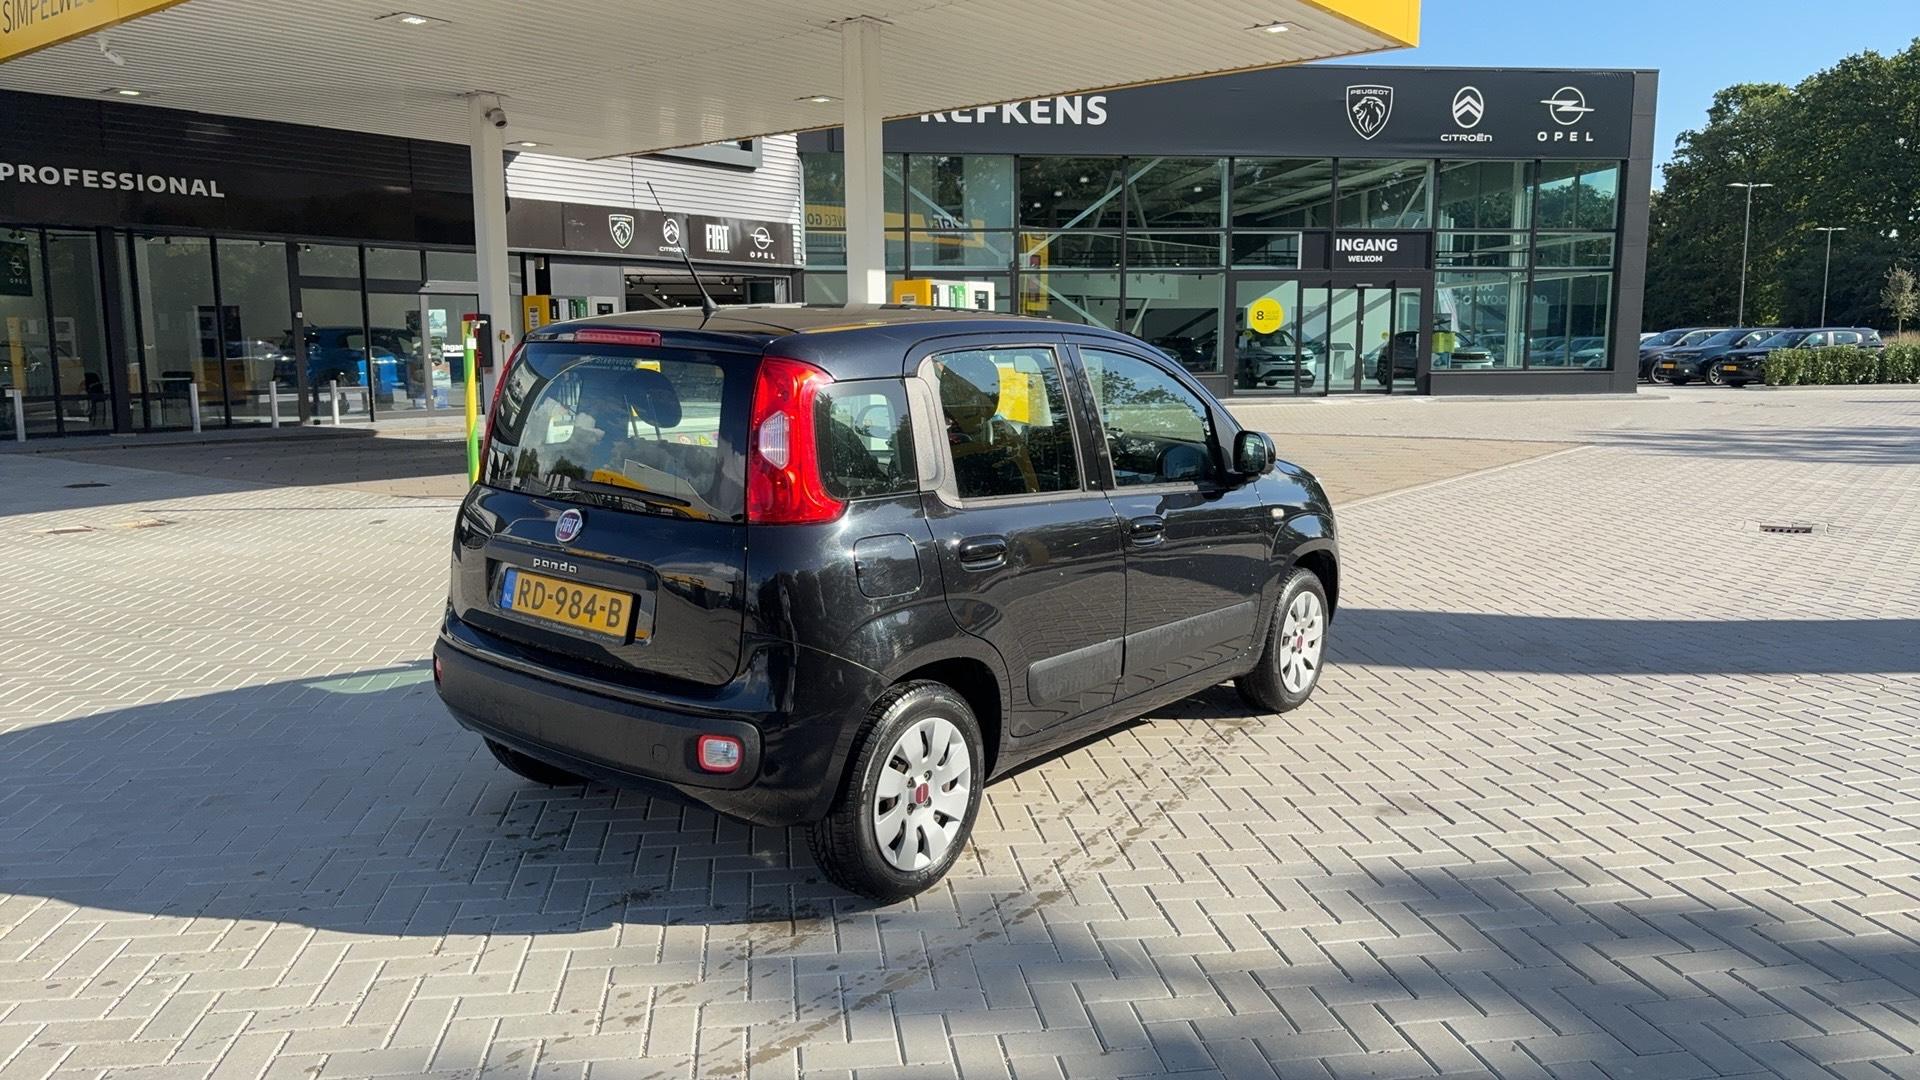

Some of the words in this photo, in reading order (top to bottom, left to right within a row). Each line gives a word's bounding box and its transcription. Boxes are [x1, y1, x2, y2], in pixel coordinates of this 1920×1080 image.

[1350, 88, 1390, 96] PEUGEOT
[1537, 131, 1594, 142] OPEL
[0, 162, 225, 198] PROFESSIONAL
[705, 223, 730, 251] FIAT
[1335, 238, 1398, 252] INGANG
[749, 251, 776, 260] OPEL
[1347, 255, 1383, 263] WELKOM
[1256, 310, 1264, 321] 8
[442, 342, 464, 353] Ingan
[560, 517, 577, 534] FIAT
[533, 557, 578, 574] panda
[517, 578, 622, 627] RD-984-B
